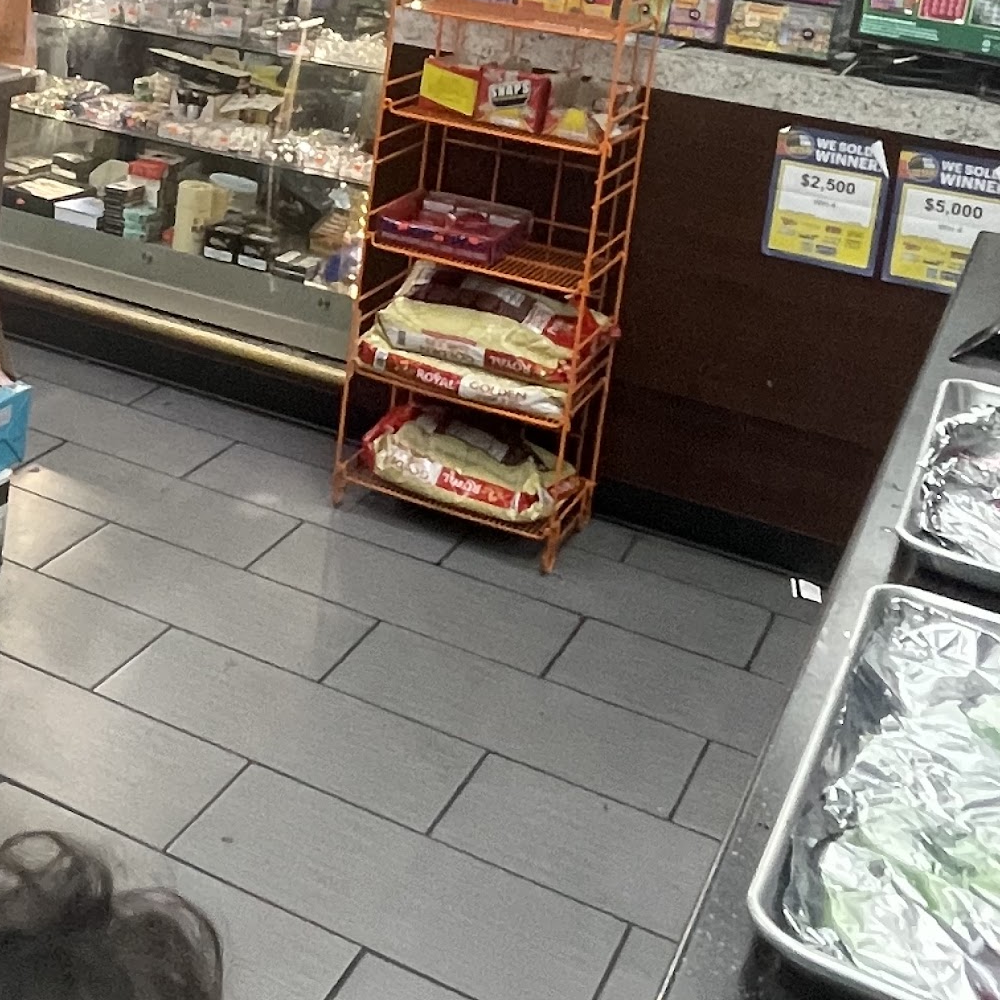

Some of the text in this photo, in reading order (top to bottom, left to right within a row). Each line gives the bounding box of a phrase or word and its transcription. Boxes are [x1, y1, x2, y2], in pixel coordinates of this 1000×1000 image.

[490, 80, 530, 100] SNAPS
[816, 137, 838, 151] WE
[941, 160, 962, 174] WE
[800, 173, 856, 195] $2,500
[924, 197, 984, 220] $5,000
[416, 366, 529, 401] ROYAL GOLDEN
